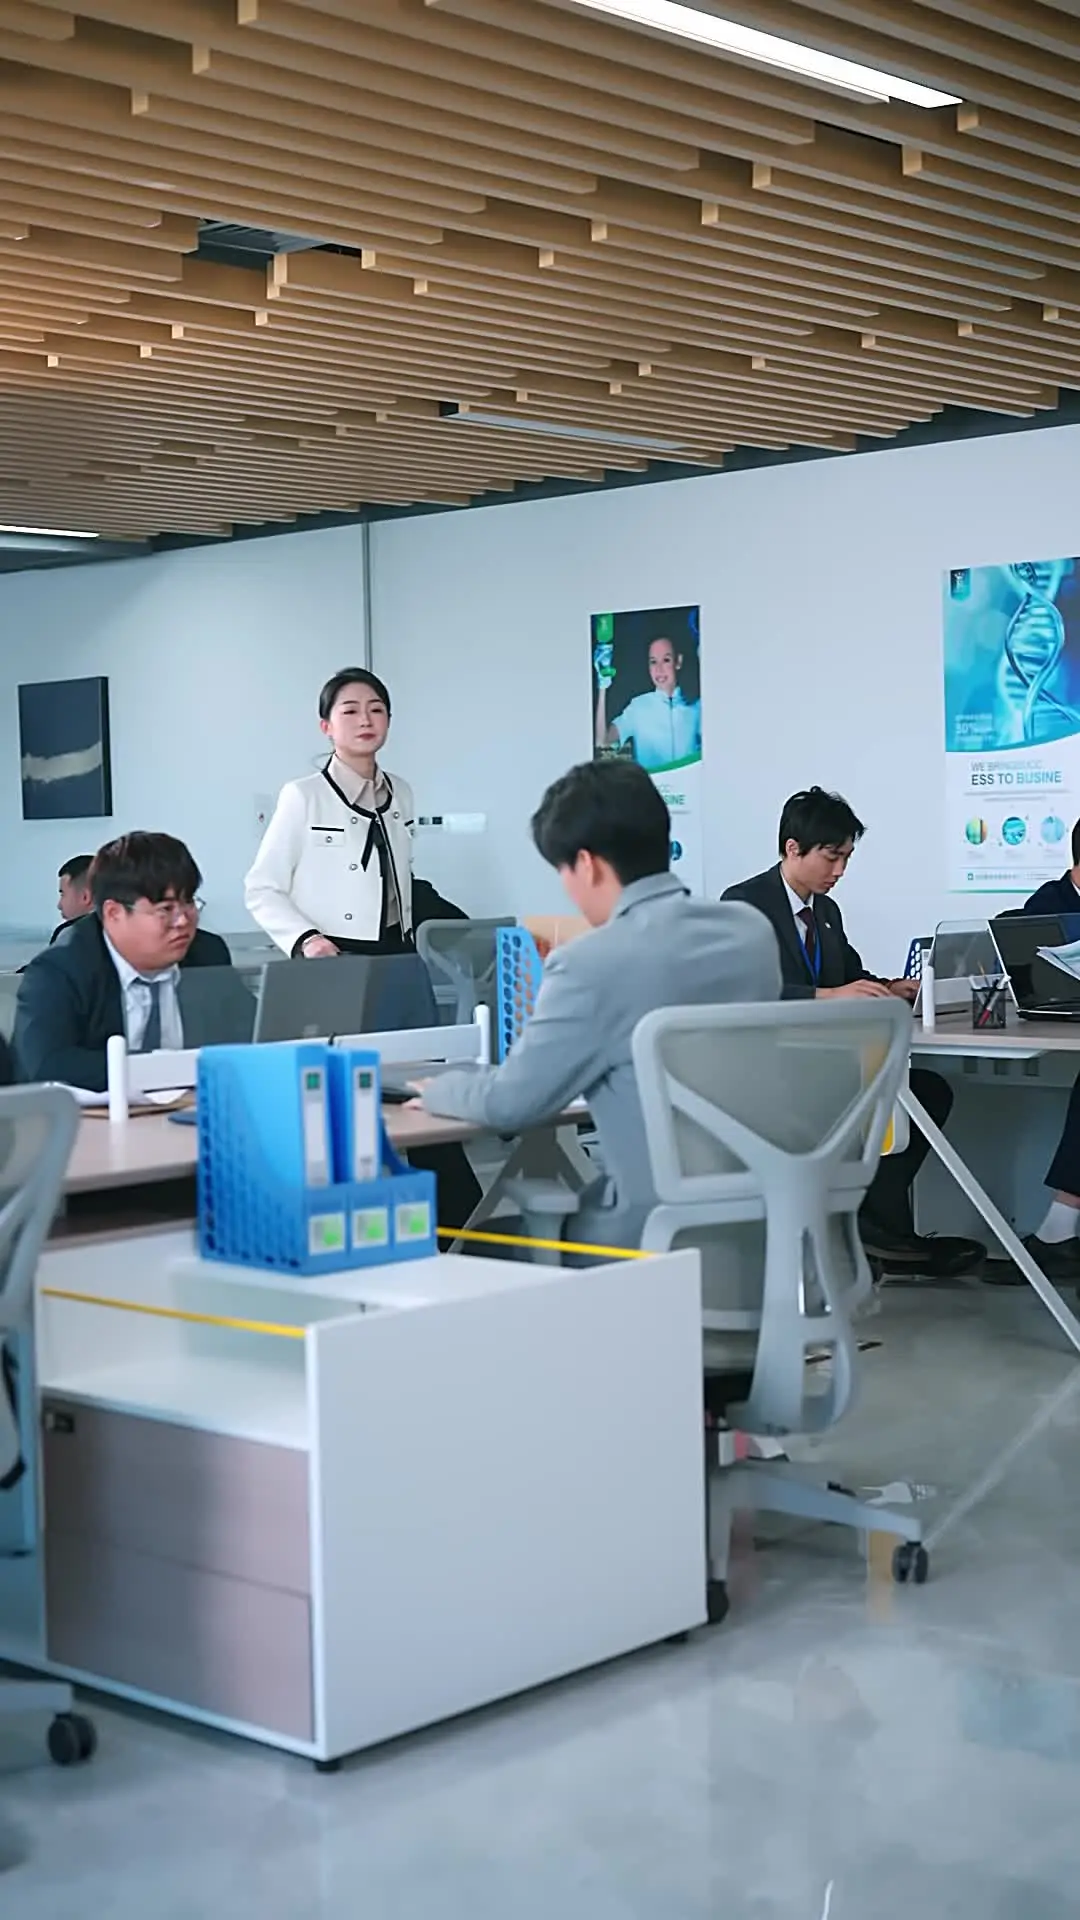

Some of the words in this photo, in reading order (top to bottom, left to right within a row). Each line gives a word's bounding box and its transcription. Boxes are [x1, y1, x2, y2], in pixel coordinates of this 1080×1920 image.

[971, 773, 995, 786] ESS
[998, 772, 1014, 785] TO
[1016, 770, 1062, 785] BUSINE
